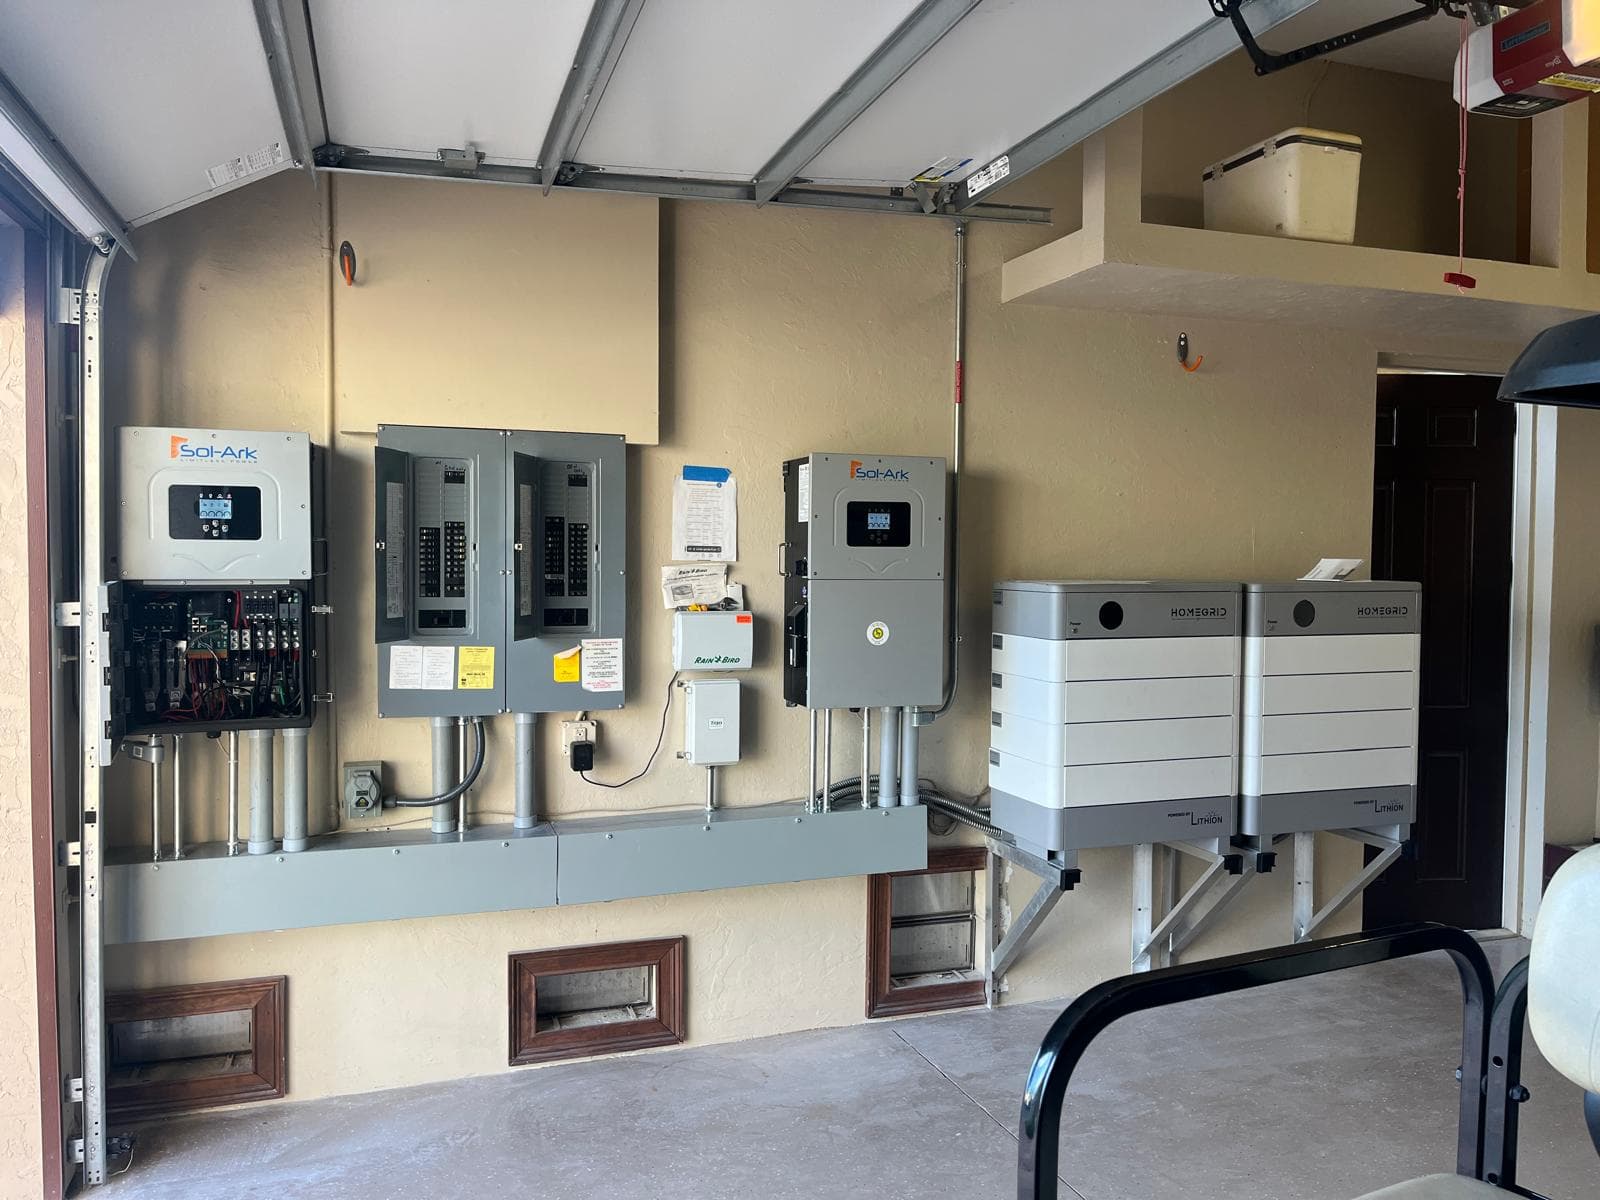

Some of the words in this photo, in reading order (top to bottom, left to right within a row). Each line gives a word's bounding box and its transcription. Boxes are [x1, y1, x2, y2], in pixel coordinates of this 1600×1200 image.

[180, 444, 258, 459] Sol-Ark
[855, 467, 910, 480] Sol-Ark
[1170, 607, 1227, 617] HOMEGRID
[1357, 606, 1408, 616] HOMEGRID
[694, 656, 714, 664] RAIN
[721, 656, 741, 664] BIRD
